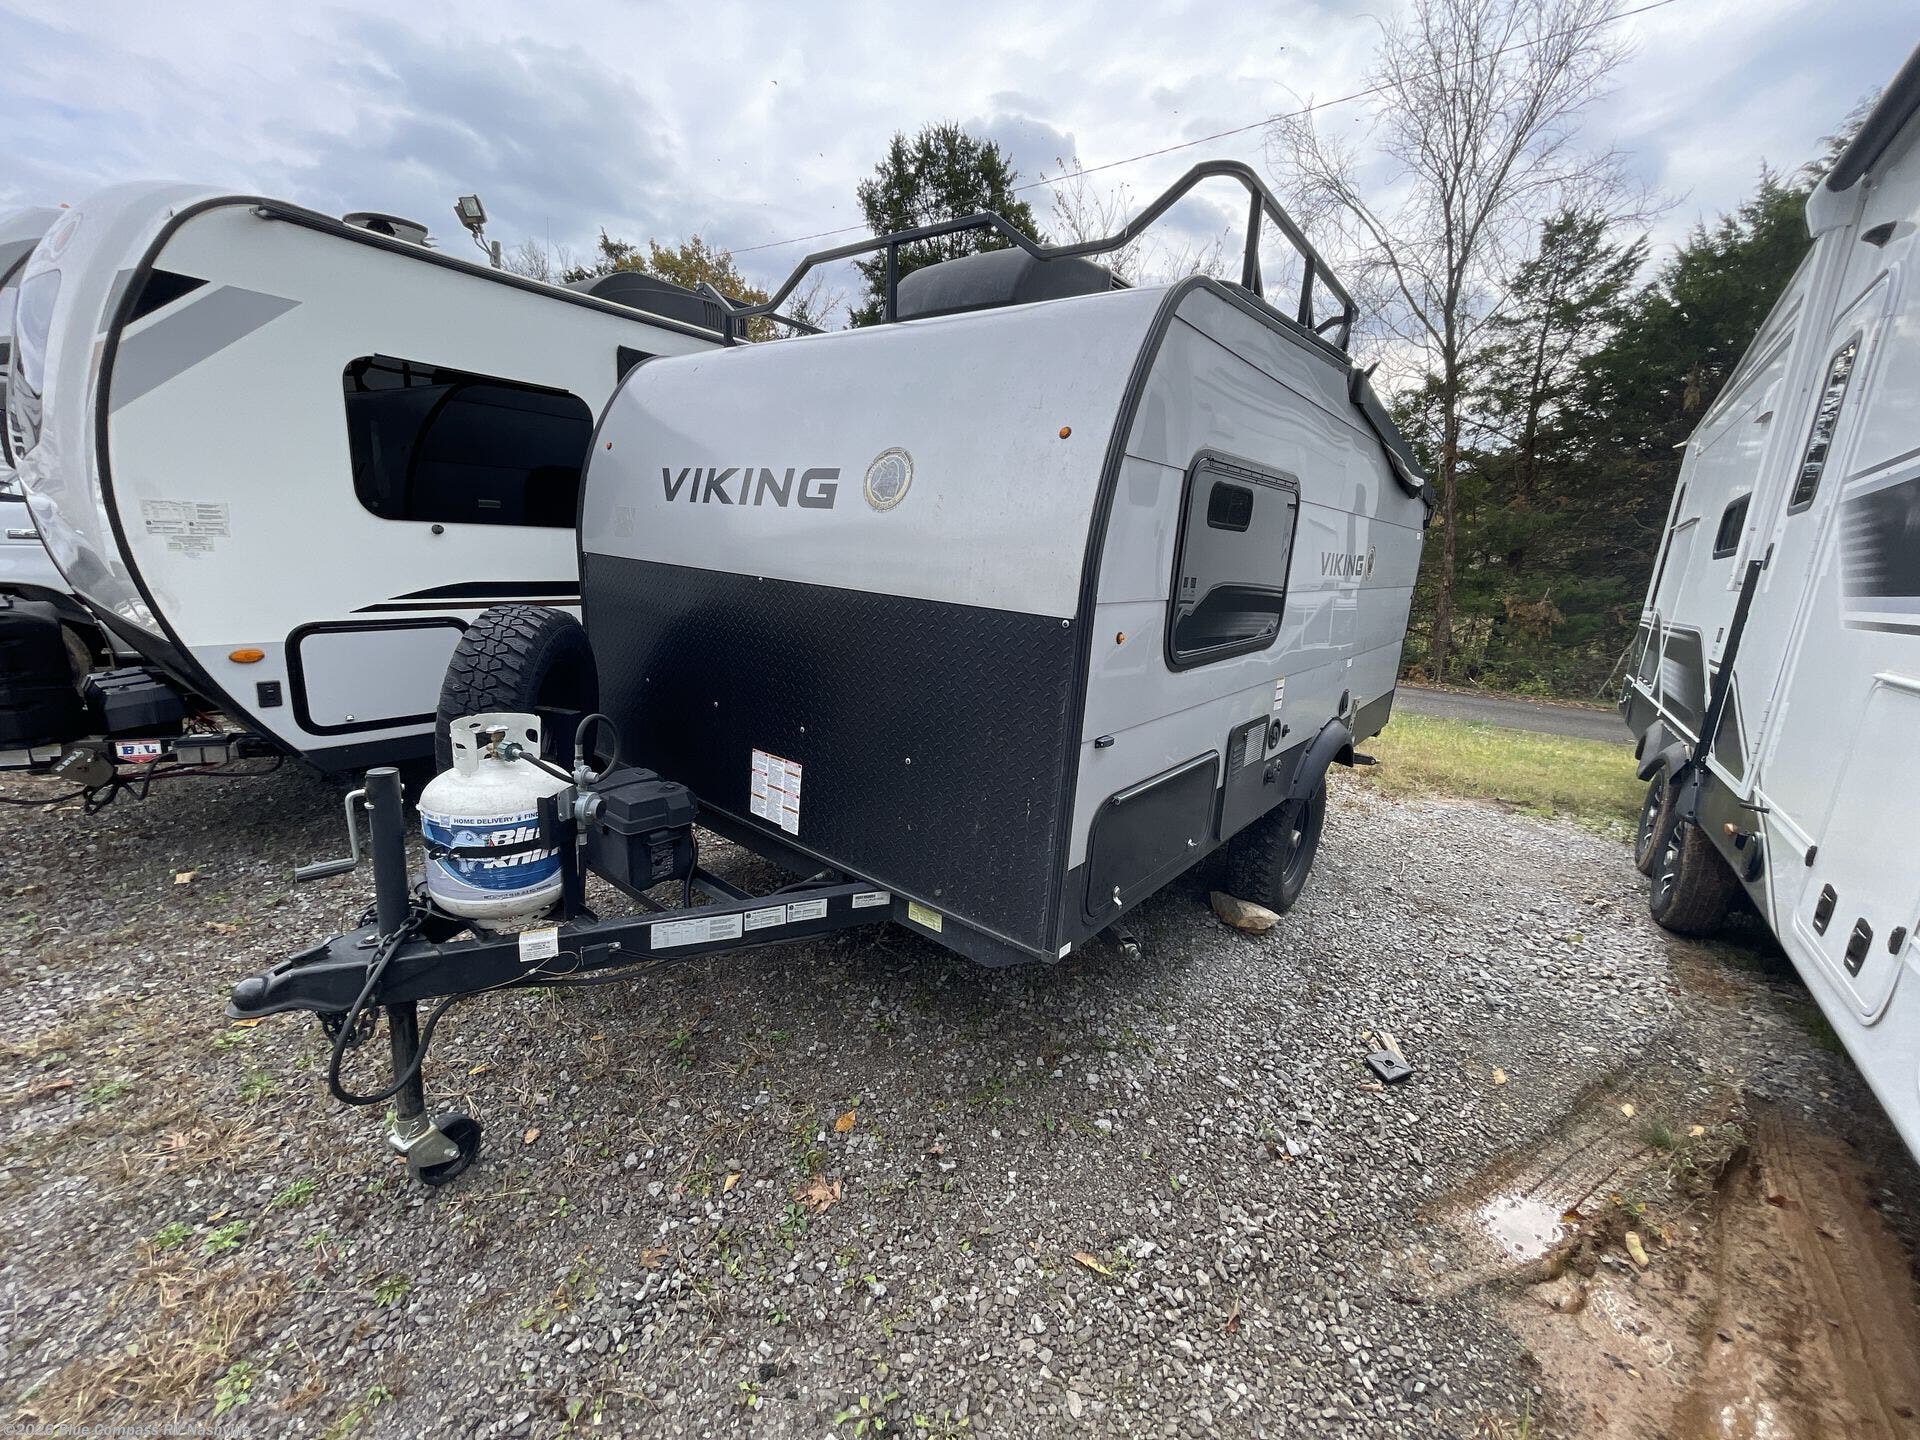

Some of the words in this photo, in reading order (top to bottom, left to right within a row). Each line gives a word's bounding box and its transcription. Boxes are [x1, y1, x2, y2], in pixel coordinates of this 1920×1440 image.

[662, 467, 841, 510] VIKING
[1321, 551, 1364, 577] VIKING
[476, 816, 514, 825] DELIVERY
